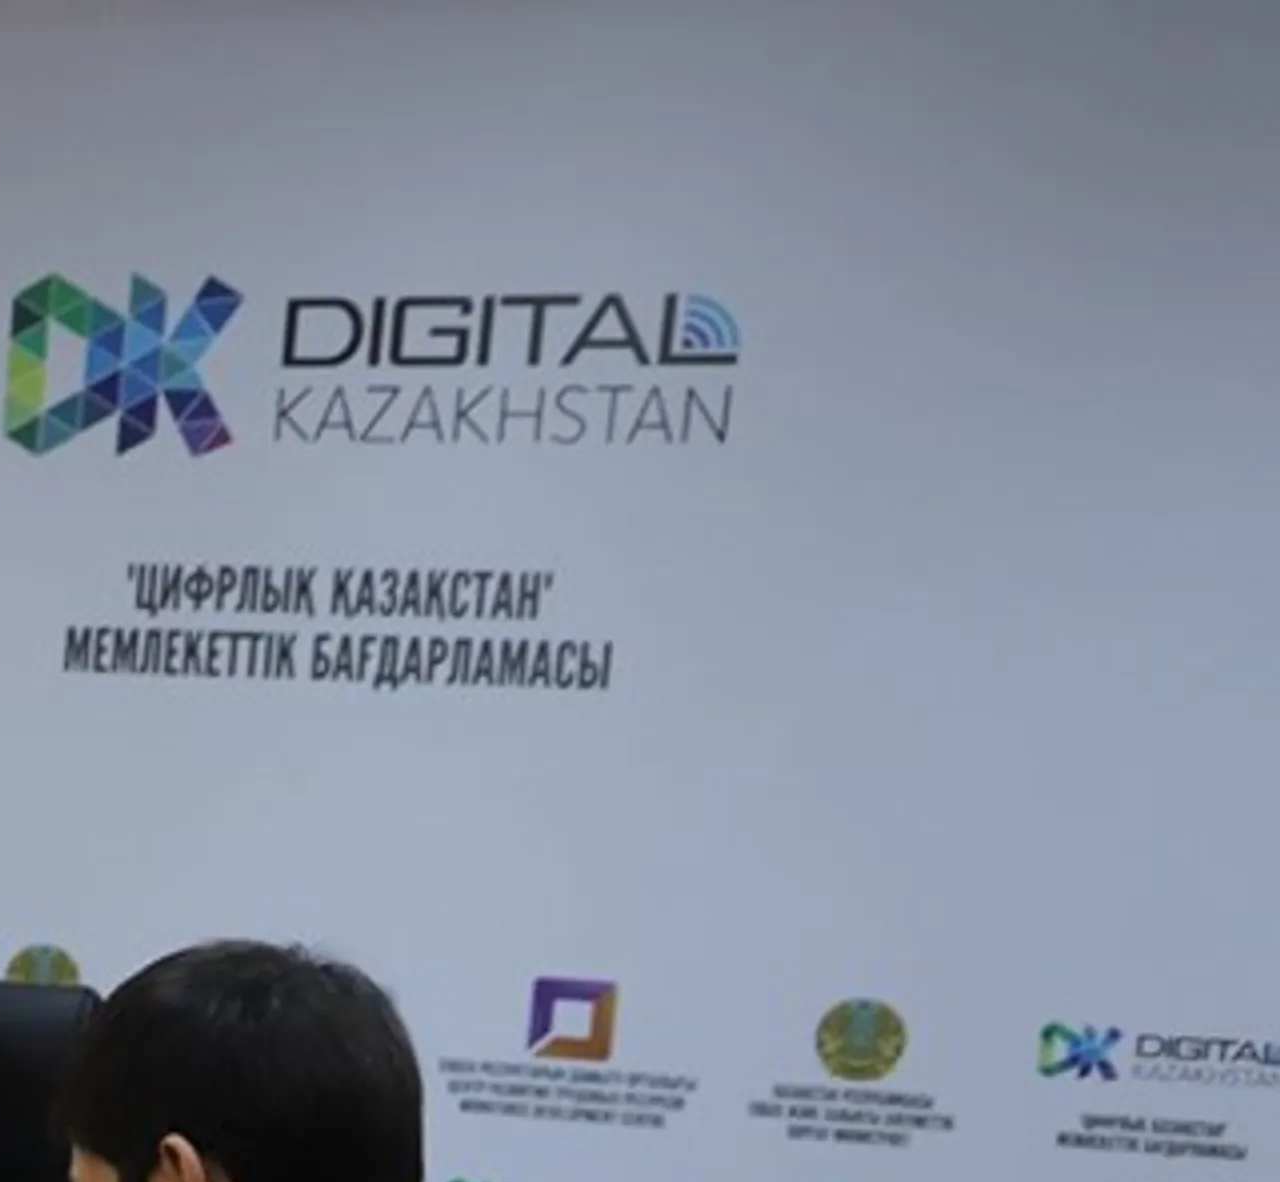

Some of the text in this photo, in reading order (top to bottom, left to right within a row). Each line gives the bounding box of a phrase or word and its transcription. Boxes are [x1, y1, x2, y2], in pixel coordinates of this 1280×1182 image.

[281, 292, 739, 368] DIGITAL
[4, 273, 244, 457] DK
[273, 384, 733, 447] KAZAKHSTAN
[64, 627, 613, 692] МЕМЛЕКЕТТІК БАҒДАРЛАМАСЫ
[1135, 1033, 1280, 1065] DIGITAL
